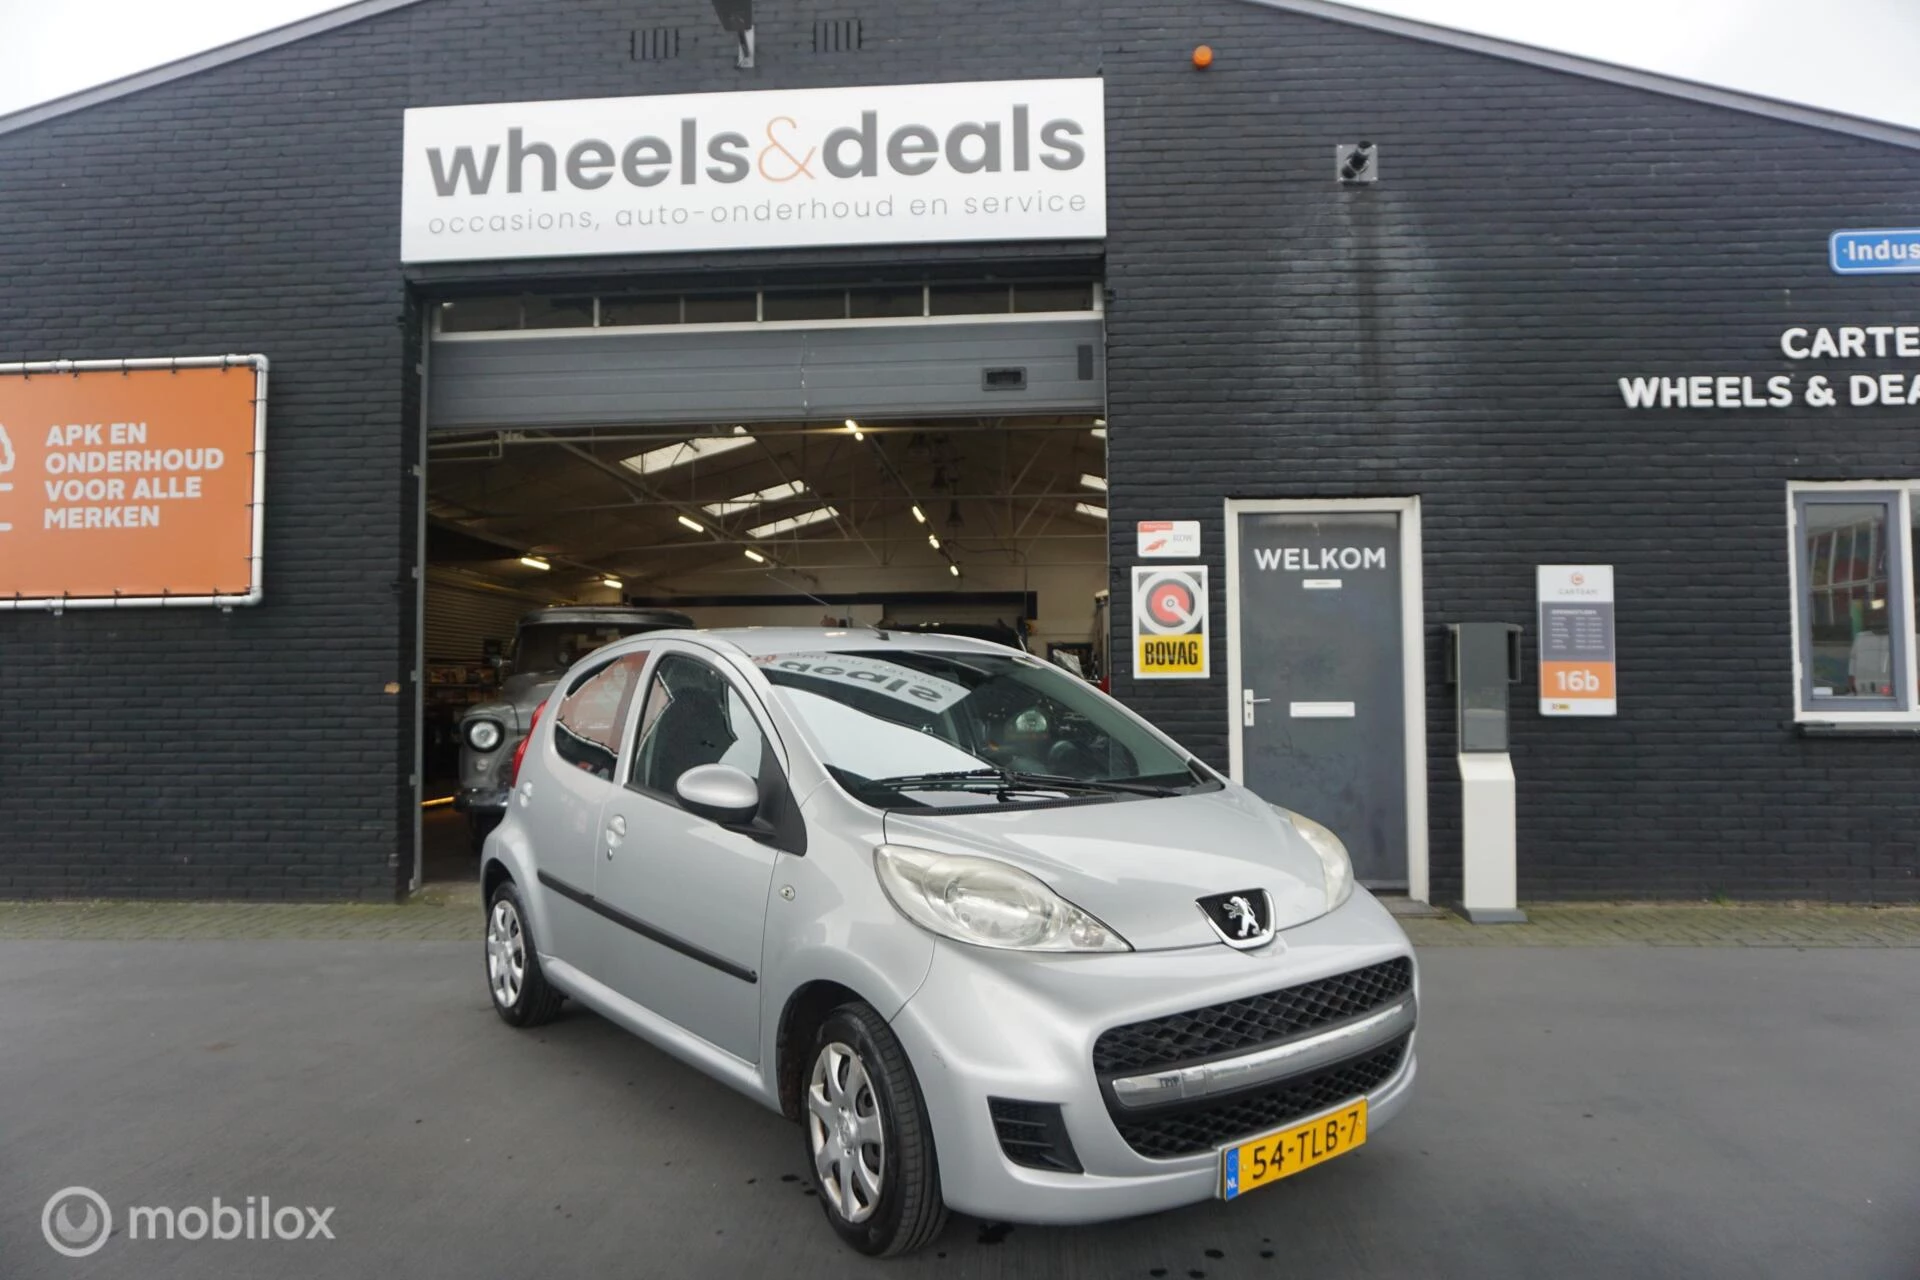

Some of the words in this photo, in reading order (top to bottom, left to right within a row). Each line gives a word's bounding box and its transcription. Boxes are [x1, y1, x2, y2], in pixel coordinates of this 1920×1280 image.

[425, 103, 1085, 197] wheels&deals
[428, 208, 600, 235] occasions,
[615, 194, 893, 227] auto-onderhoud
[909, 197, 947, 216] en
[964, 190, 1086, 214] service
[1780, 326, 1920, 359] CARTE
[1618, 375, 1794, 408] WHEELS
[1804, 375, 1836, 408] &
[46, 423, 103, 447] APK
[110, 422, 147, 445] EN
[45, 448, 224, 474] ONDERHOUD
[44, 478, 124, 502] VOOR
[132, 476, 202, 499] ALLE
[44, 505, 160, 529] MERKEN
[1254, 547, 1386, 570] WELKOM
[1144, 641, 1199, 666] BOVAG
[1555, 669, 1600, 692] 16b
[1227, 1177, 1238, 1191] NL
[1252, 1110, 1359, 1180] 54-TLB-7
